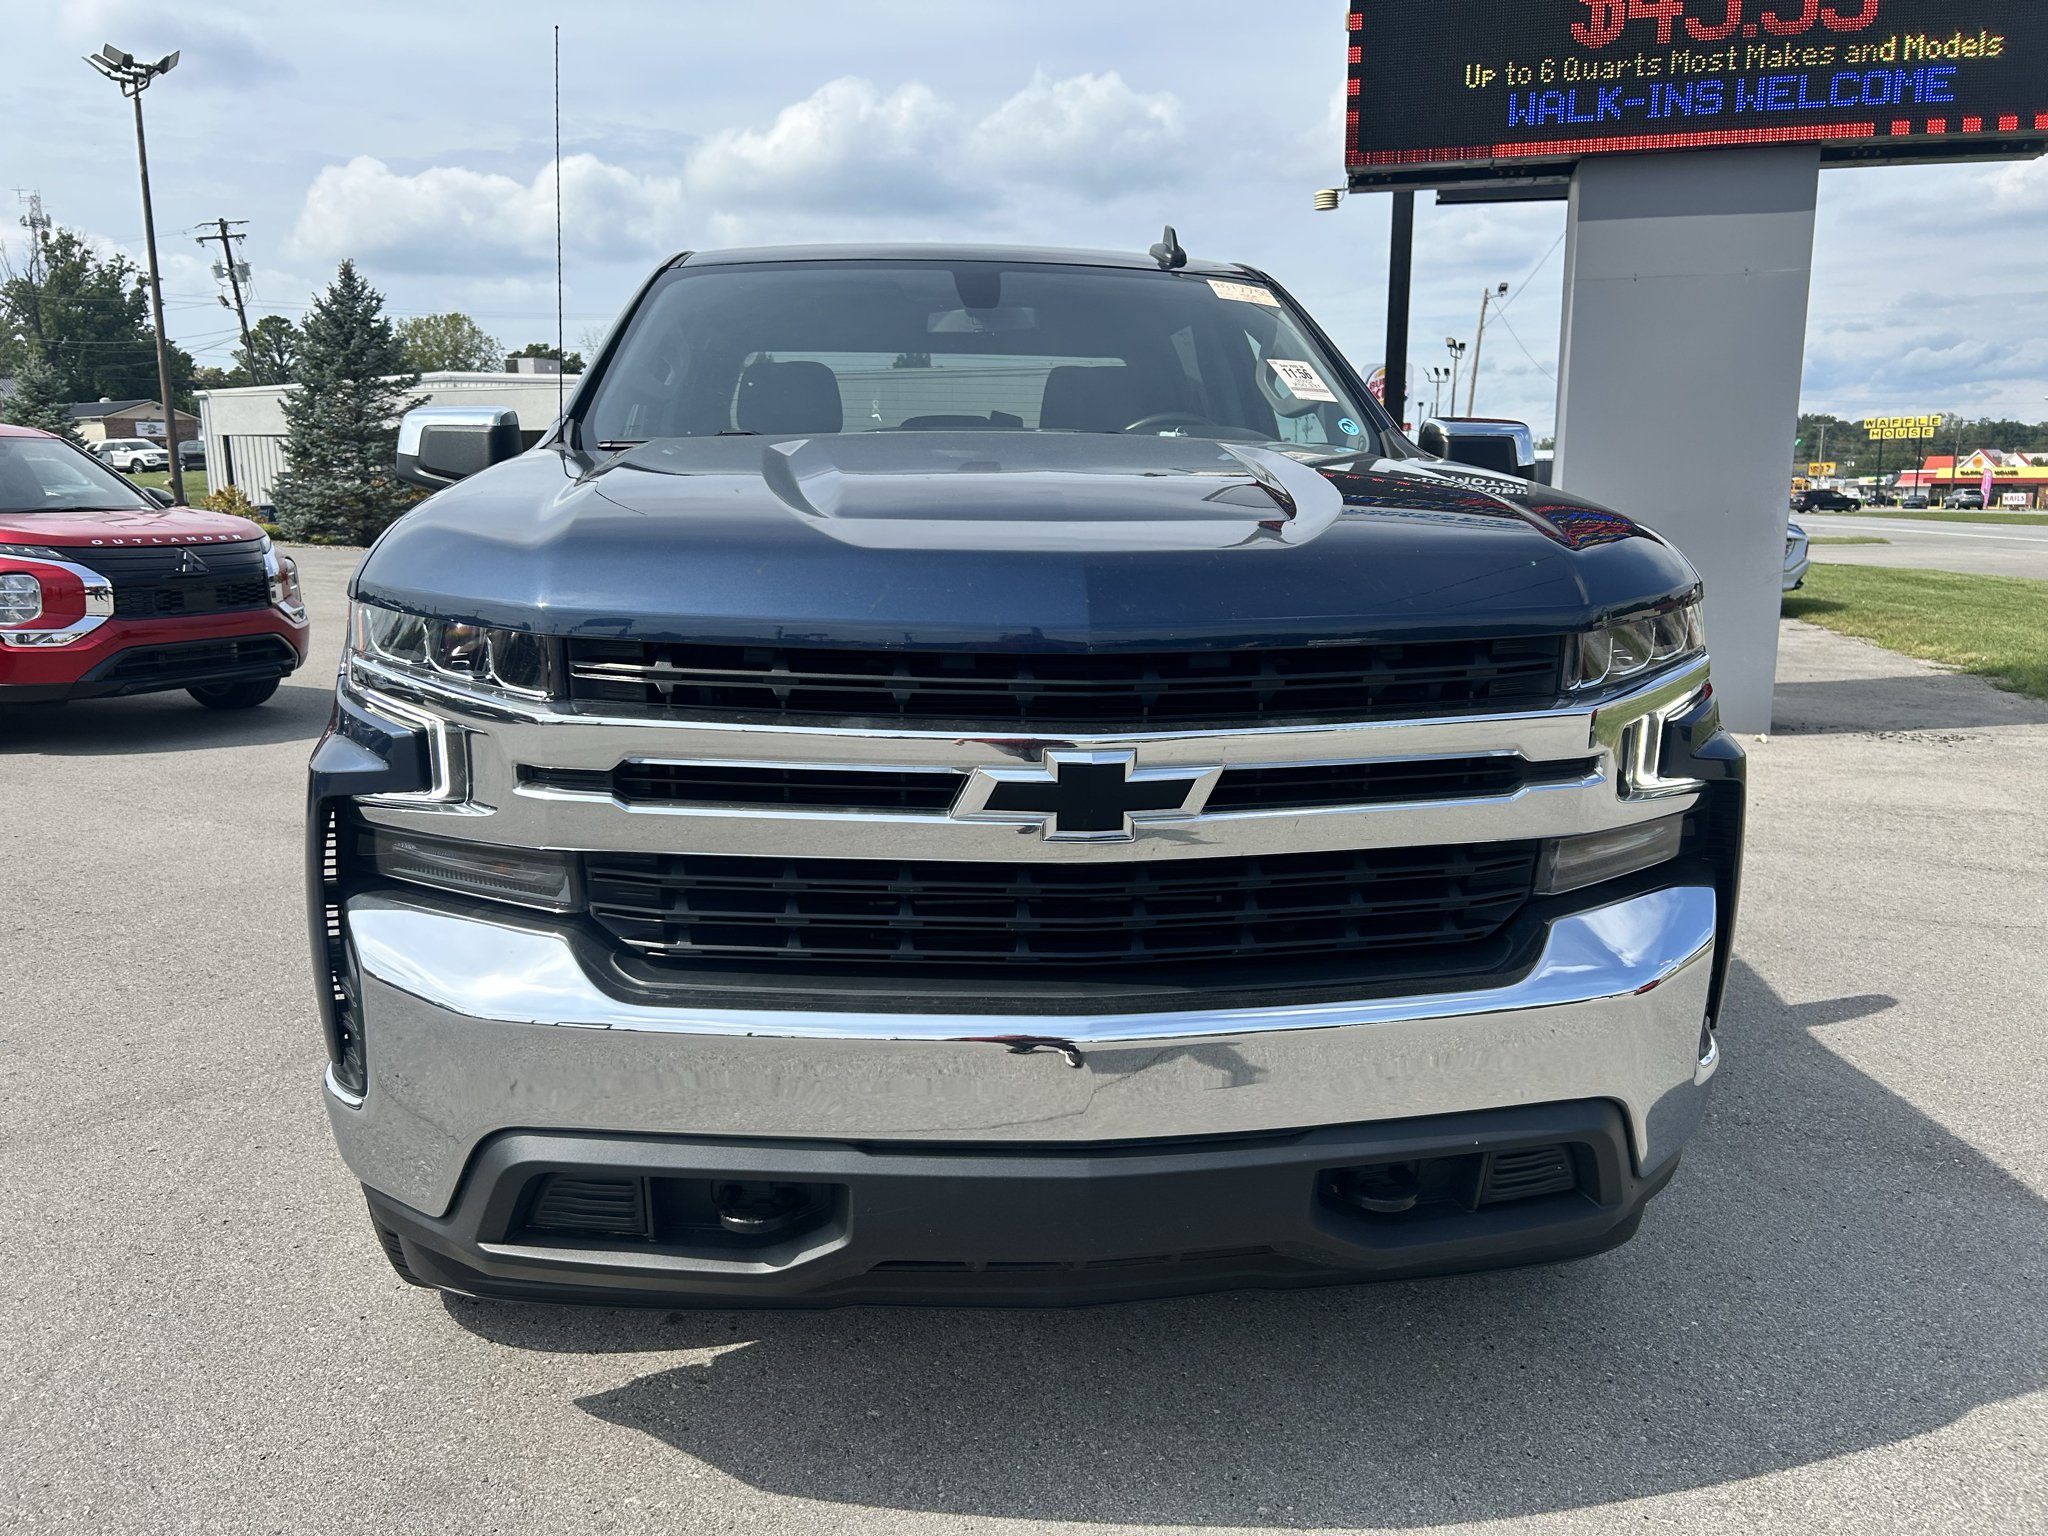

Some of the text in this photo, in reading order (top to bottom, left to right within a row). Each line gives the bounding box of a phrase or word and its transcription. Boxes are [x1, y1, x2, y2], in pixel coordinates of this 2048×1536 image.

[1465, 29, 2005, 88] Up to 6 Quarts Most Makes and Models
[1507, 66, 1957, 127] WALK-INS WELCOME
[1282, 368, 1313, 379] 11:56
[1865, 417, 1940, 428] WAFFLE
[1871, 428, 1932, 436] HOUSE
[91, 534, 243, 546] OUTLANDER
